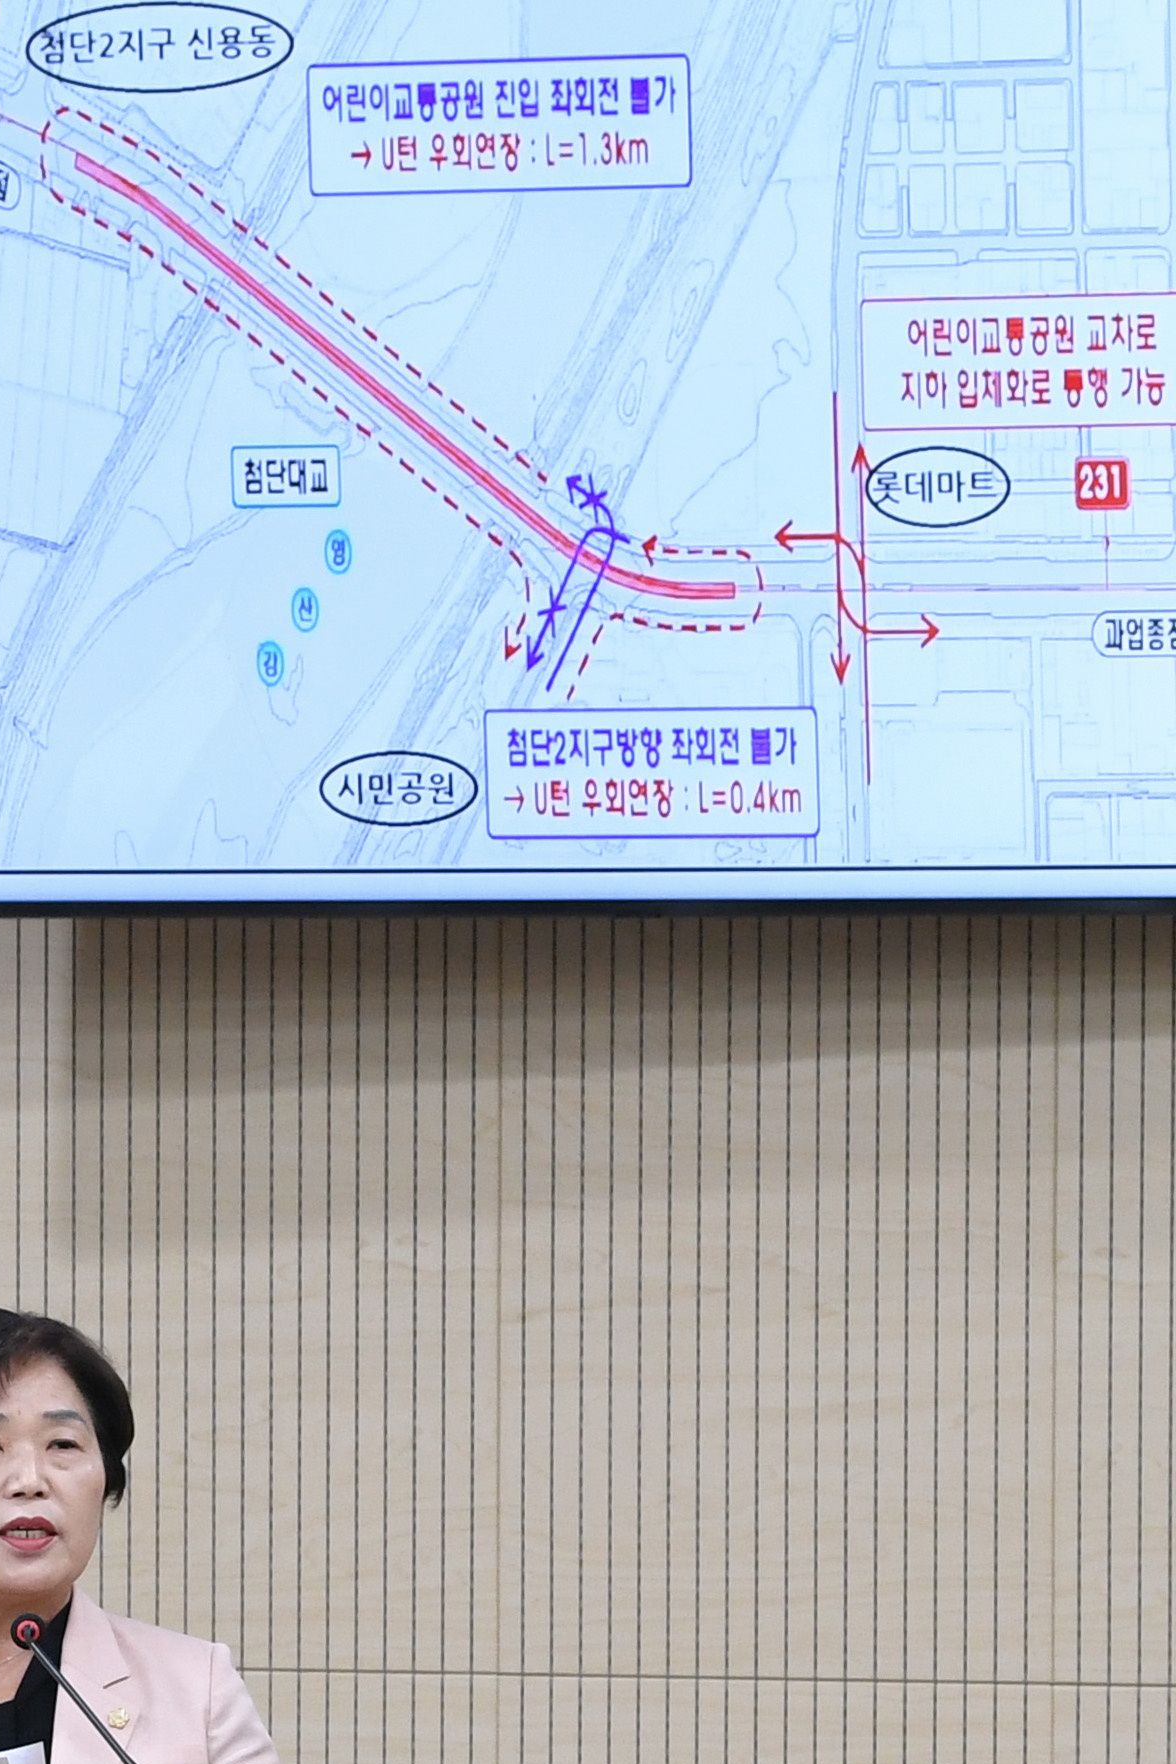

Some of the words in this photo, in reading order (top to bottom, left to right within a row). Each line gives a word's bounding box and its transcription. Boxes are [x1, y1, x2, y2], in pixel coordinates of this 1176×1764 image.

[40, 27, 176, 64] 첨단2지구
[187, 23, 277, 61] 신용동
[322, 78, 484, 122] 어린이교통공원
[495, 77, 539, 119] 진입
[551, 76, 619, 116] 좌회전
[381, 135, 417, 172] U턴
[429, 132, 520, 172] 우회연장
[908, 314, 1074, 357] 어린이교통공원
[1087, 312, 1157, 353] 교차로
[901, 371, 947, 409] 지하
[957, 368, 1051, 408] 입체화로
[1064, 367, 1108, 408] 통행
[1122, 366, 1166, 406] 가능
[245, 459, 328, 496] 첨단대교
[873, 471, 998, 504] 롯데마트
[1080, 463, 1122, 500] 231
[298, 596, 313, 622] 산
[507, 726, 663, 769] 첨단2지구방향
[672, 727, 740, 766] 좌회전
[750, 727, 797, 766] 불가
[337, 771, 456, 807] 시민공원
[535, 780, 570, 818] U턴
[582, 778, 674, 818] 우회연장
[698, 780, 802, 815] L=0.4km
